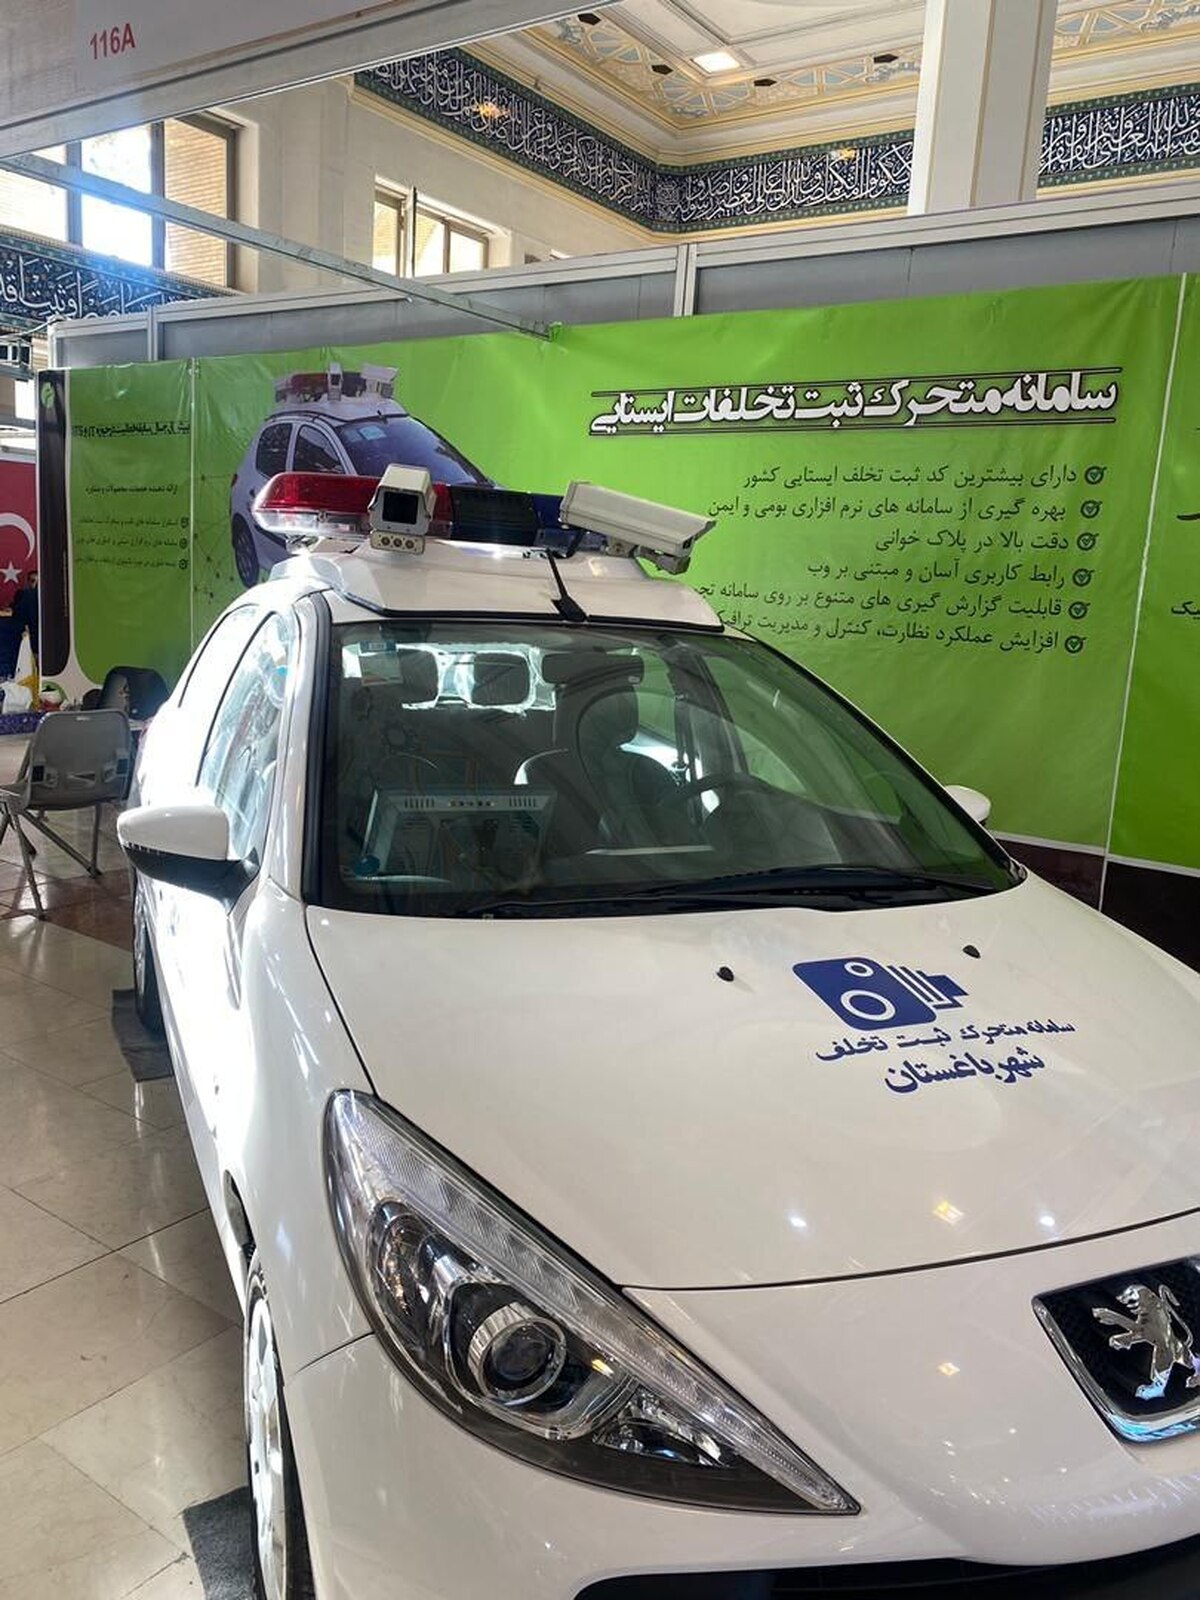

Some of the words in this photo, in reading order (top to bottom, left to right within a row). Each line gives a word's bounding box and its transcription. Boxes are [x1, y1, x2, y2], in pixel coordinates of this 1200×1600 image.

[90, 23, 135, 59] 116A
[1000, 370, 1117, 412] سامانه
[590, 389, 676, 434] ایستایی
[673, 386, 796, 422] تخلفات
[794, 380, 864, 428] ثبت
[862, 378, 1001, 426] متحرک
[743, 466, 781, 488] کشور
[784, 465, 838, 489] ایستایی
[843, 466, 884, 484] تخلف
[889, 466, 920, 483] ثبت
[926, 465, 949, 483] کد
[954, 466, 1024, 488] بیشترین
[1030, 464, 1077, 489] دارای
[708, 496, 739, 517] ایمن
[742, 503, 750, 517] و
[754, 502, 787, 518] بومی
[792, 496, 836, 519] افزاری
[840, 504, 863, 519] نرم
[868, 497, 900, 518] های
[905, 497, 953, 515] سامانه
[958, 497, 973, 520] از
[978, 497, 1025, 520] گیری
[1031, 503, 1066, 522] بهره
[875, 528, 920, 552] خوانی
[926, 529, 967, 551] پلاک
[974, 534, 994, 554] در
[1000, 531, 1024, 549] بالا
[1030, 532, 1069, 550] دقت
[807, 564, 831, 578] وب
[835, 565, 849, 579] بر
[854, 562, 899, 581] مبتنی
[905, 569, 913, 582] و
[918, 558, 960, 583] آسان
[964, 563, 1023, 587] کاربری
[1028, 565, 1066, 589] رابط
[720, 582, 759, 599] سامانه
[764, 591, 791, 606] روی
[798, 593, 809, 607] بر
[814, 591, 855, 609] متنوع
[860, 588, 891, 610] های
[897, 591, 941, 613] گیری
[945, 594, 1002, 618] گزارش
[1008, 596, 1063, 619] قابلیت
[757, 617, 808, 635] مدیریت
[814, 623, 822, 637] و
[826, 617, 872, 639] کنترل
[935, 626, 994, 647] عملکرد
[1000, 630, 1059, 654] افزایش
[958, 1023, 1027, 1044] متحرک
[1026, 1019, 1076, 1034] سامانه
[896, 1027, 952, 1048] ثبت
[815, 1036, 888, 1062] تخلف
[884, 1052, 996, 1094] باغستان
[995, 1046, 1045, 1083] شهر
